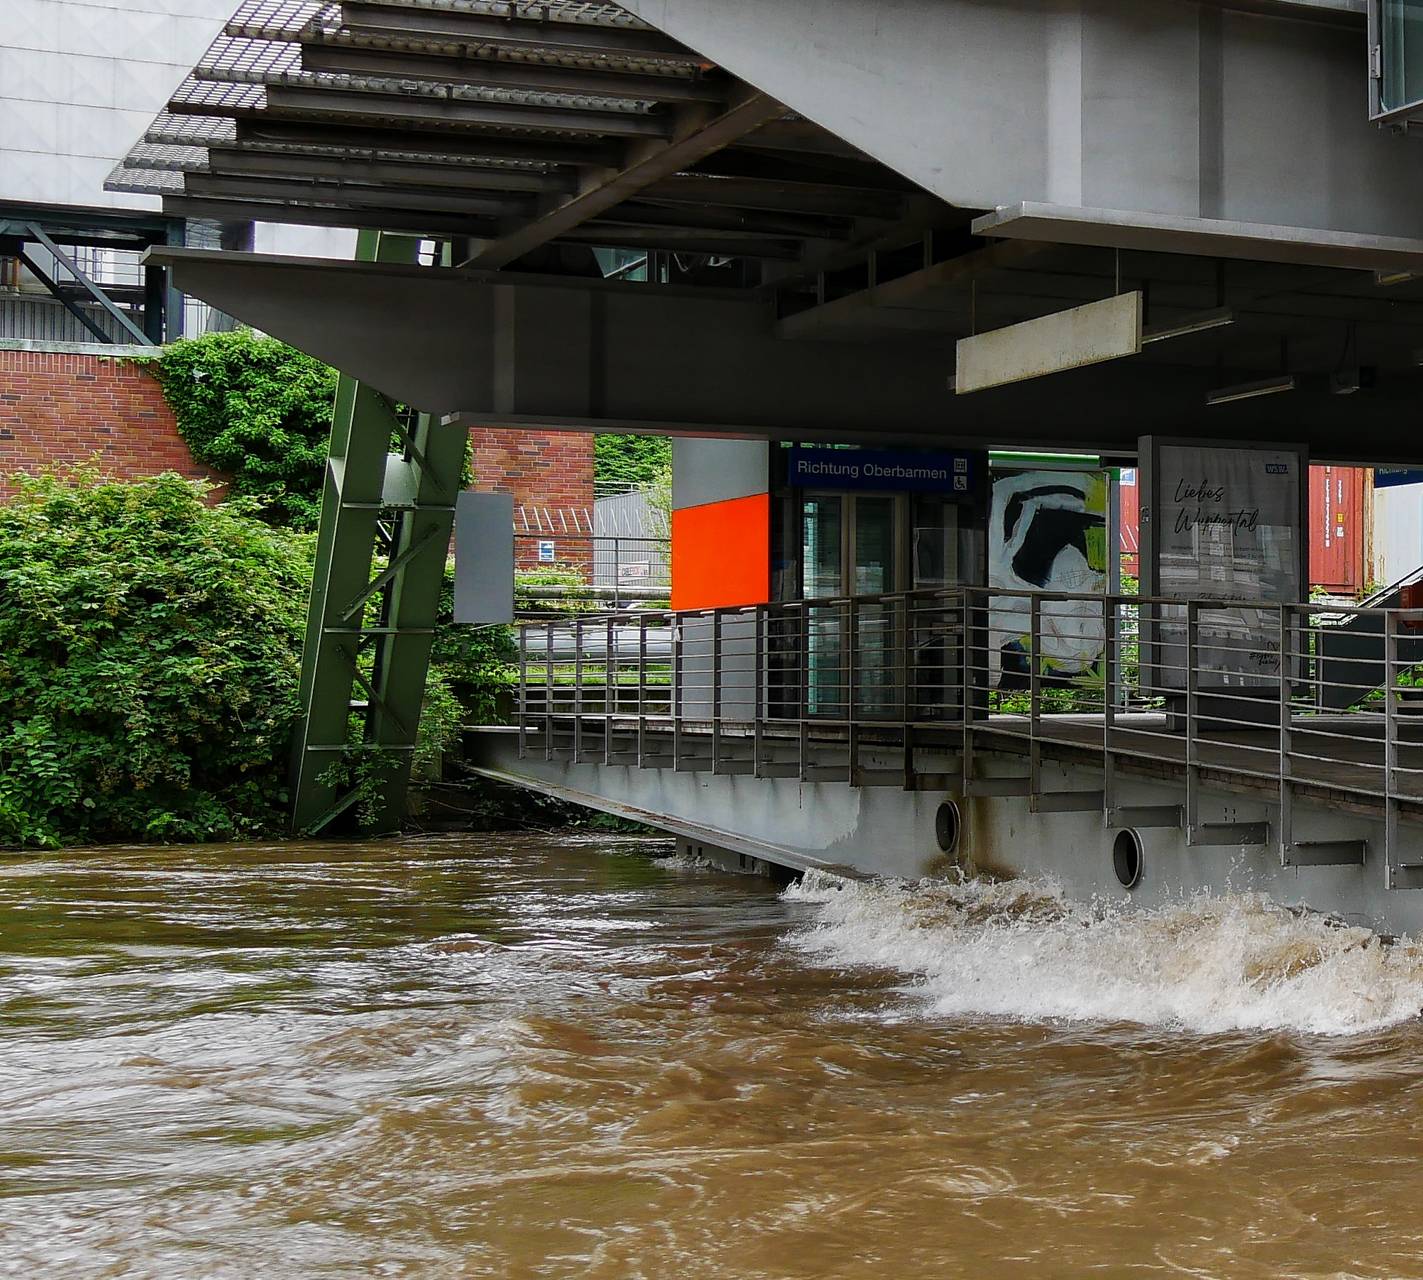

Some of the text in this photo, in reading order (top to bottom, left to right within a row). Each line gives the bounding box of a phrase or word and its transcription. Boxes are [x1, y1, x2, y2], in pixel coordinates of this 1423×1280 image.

[797, 460, 947, 479] Richtung Oberbarmen
[1175, 478, 1224, 502] Liebes
[1175, 508, 1259, 536] Wuppertal
